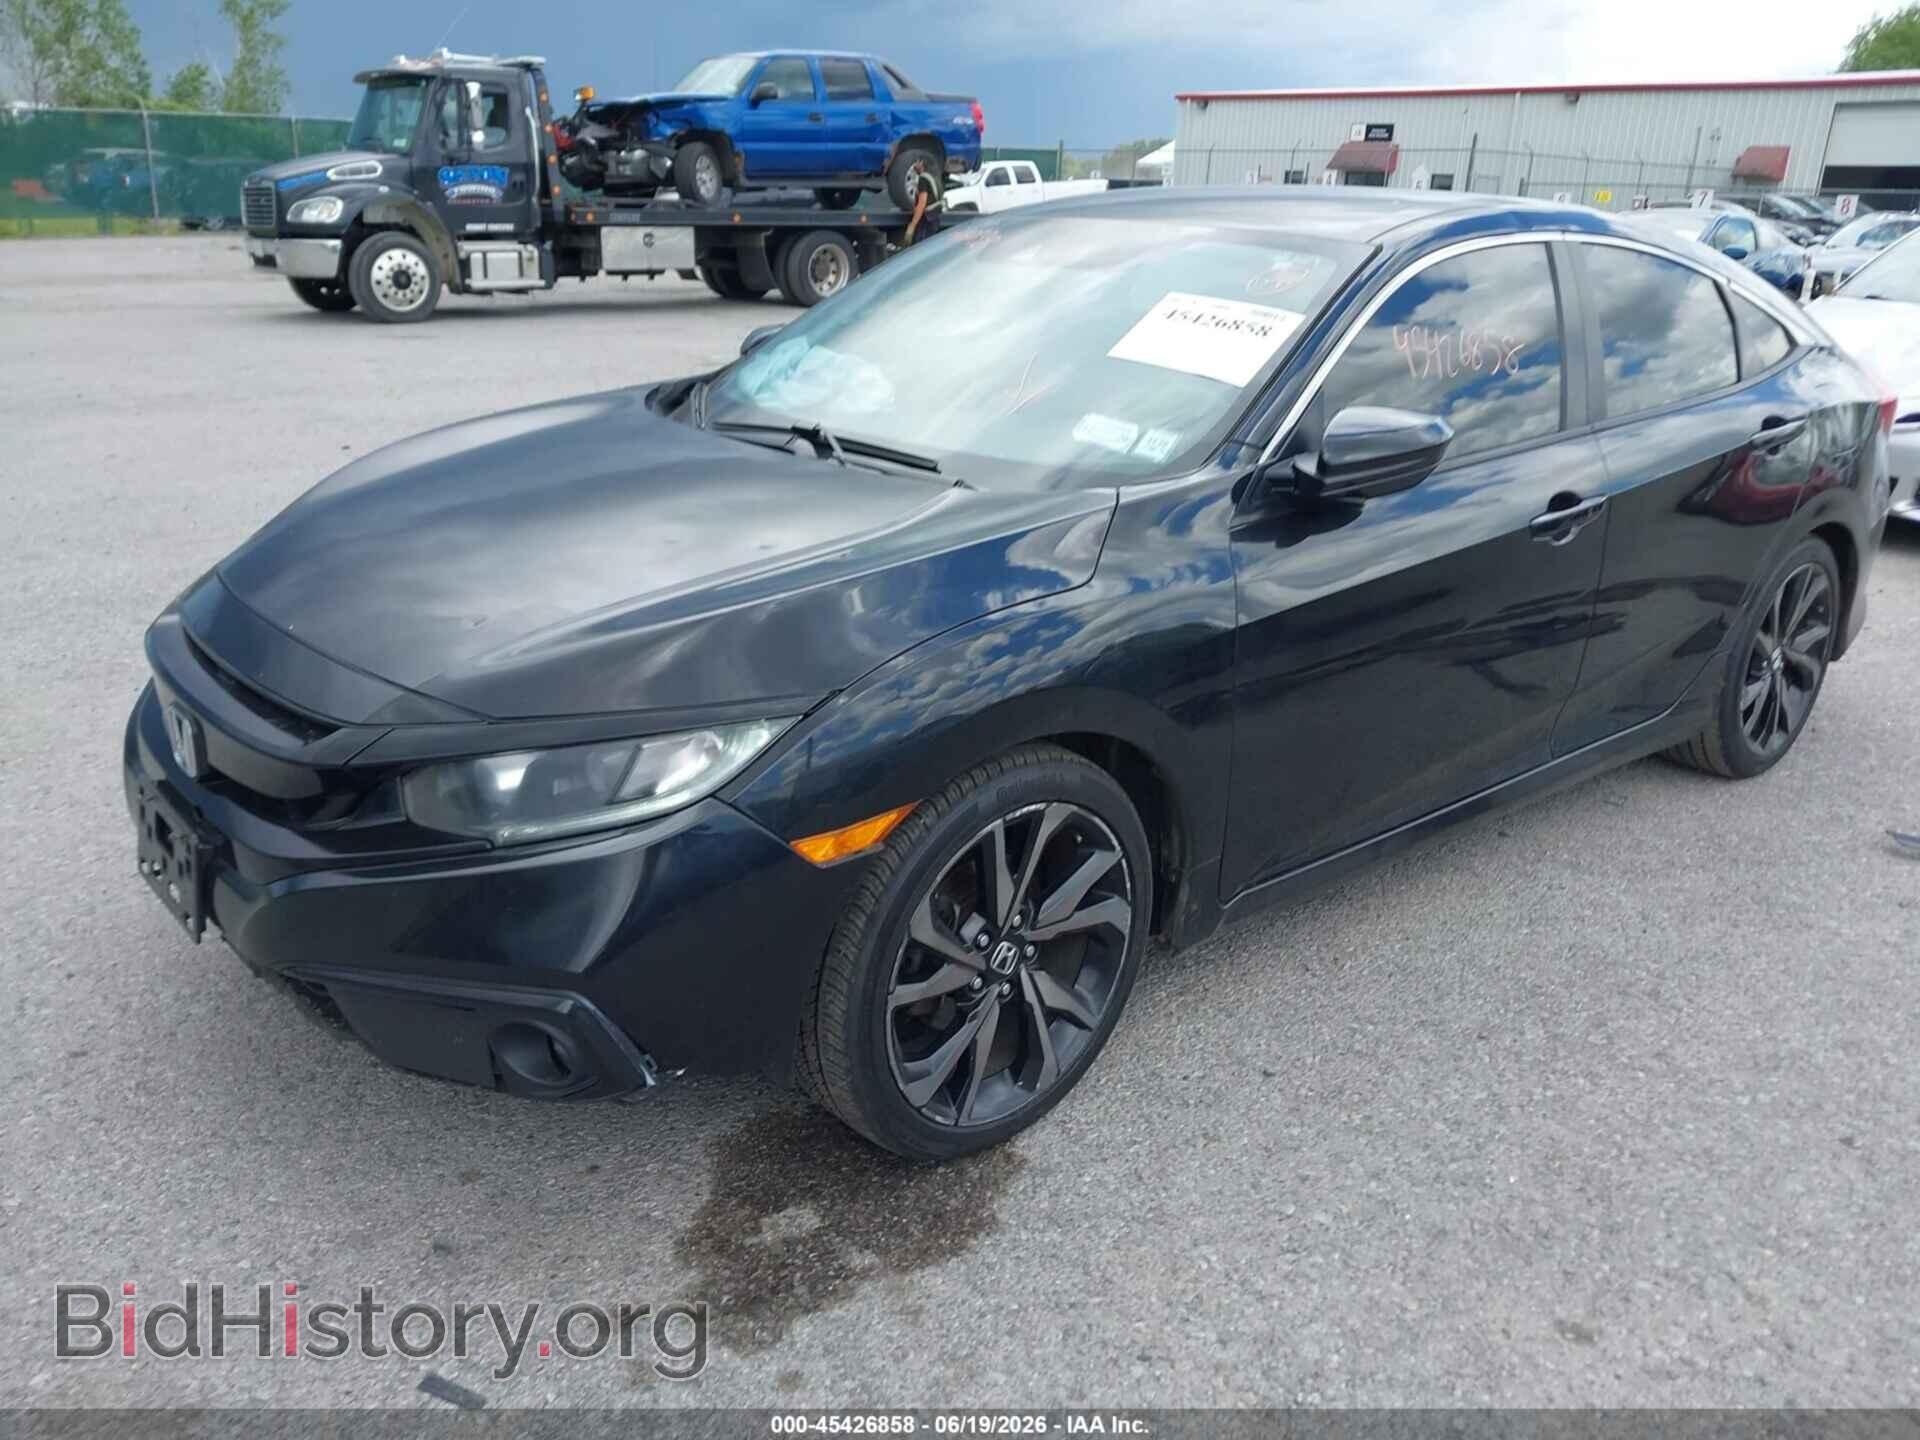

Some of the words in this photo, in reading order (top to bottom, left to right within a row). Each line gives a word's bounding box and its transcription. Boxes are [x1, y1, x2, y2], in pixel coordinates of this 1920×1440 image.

[1699, 191, 1708, 208] 7
[1840, 198, 1852, 215] 8
[1162, 308, 1273, 338] 45426858
